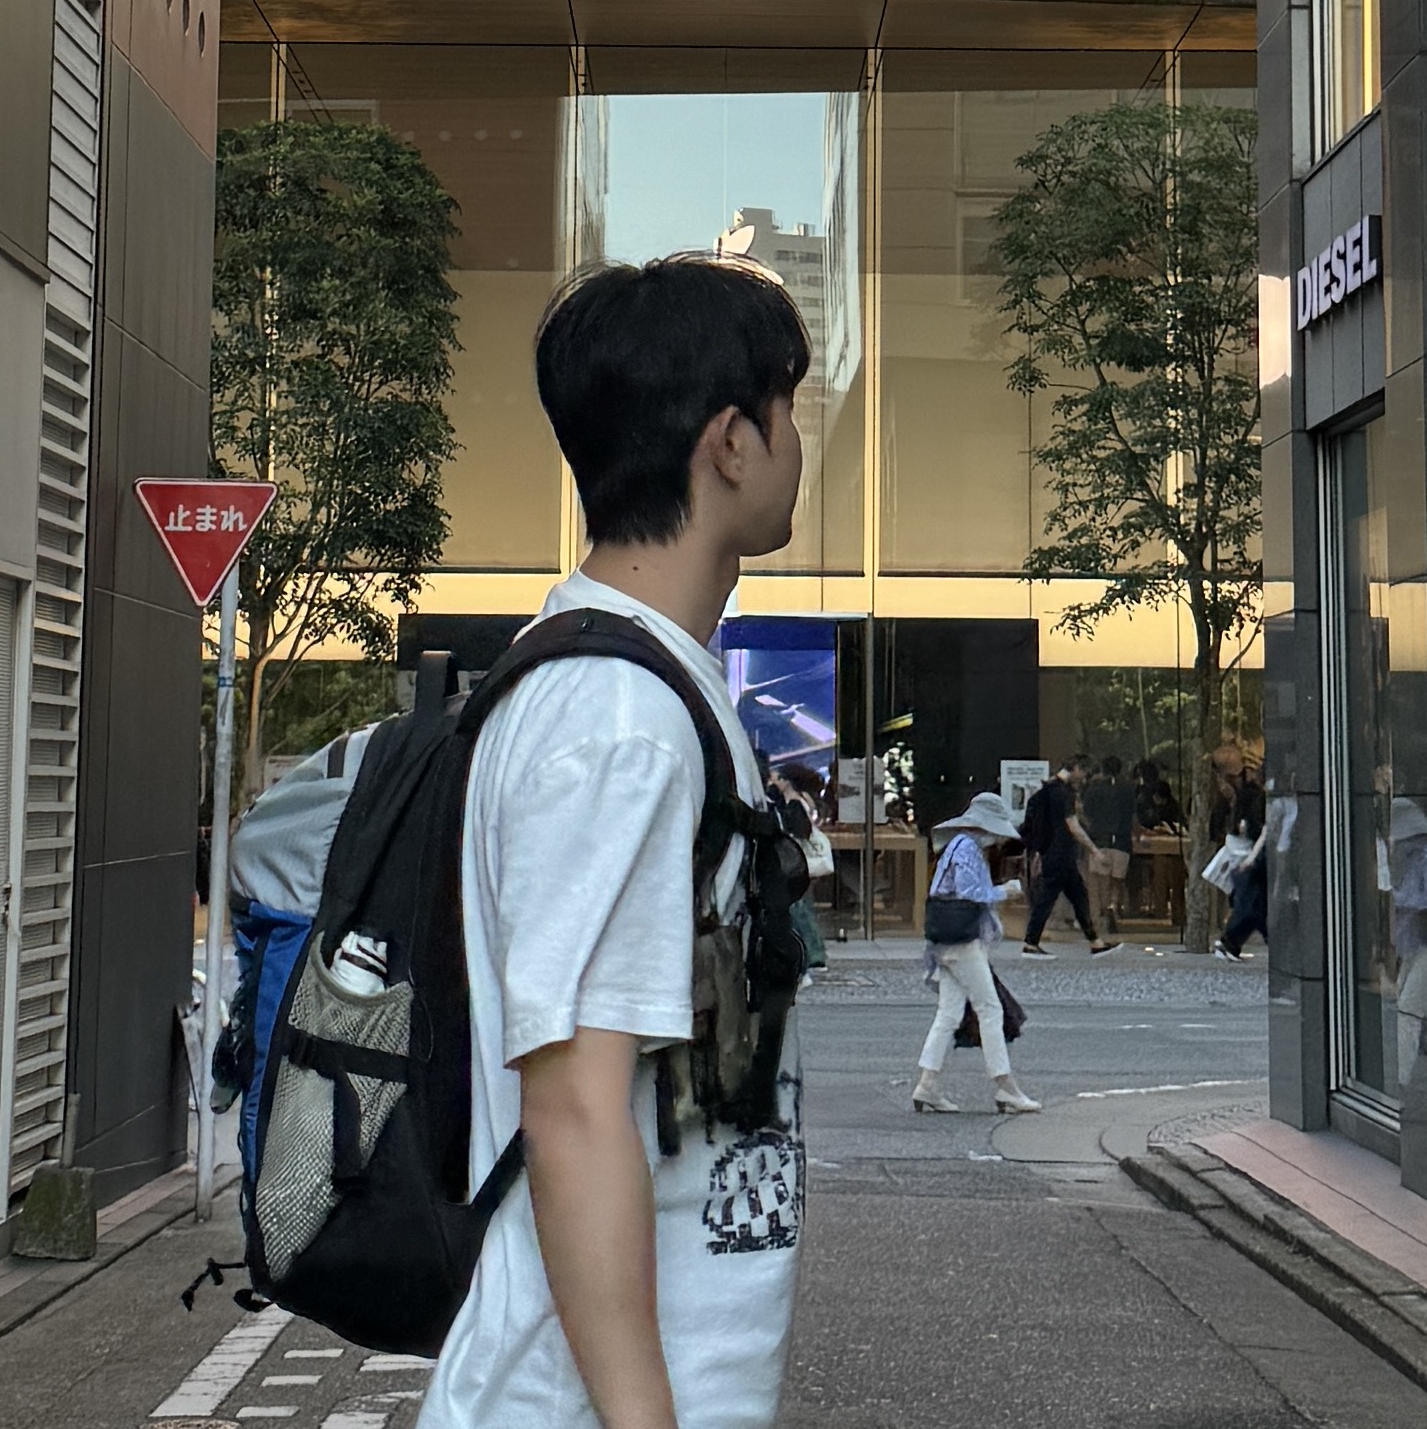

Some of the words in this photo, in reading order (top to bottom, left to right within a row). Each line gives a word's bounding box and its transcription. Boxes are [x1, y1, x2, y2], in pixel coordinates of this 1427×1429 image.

[1297, 215, 1378, 331] DIESEL
[165, 504, 248, 533] 止まれ
